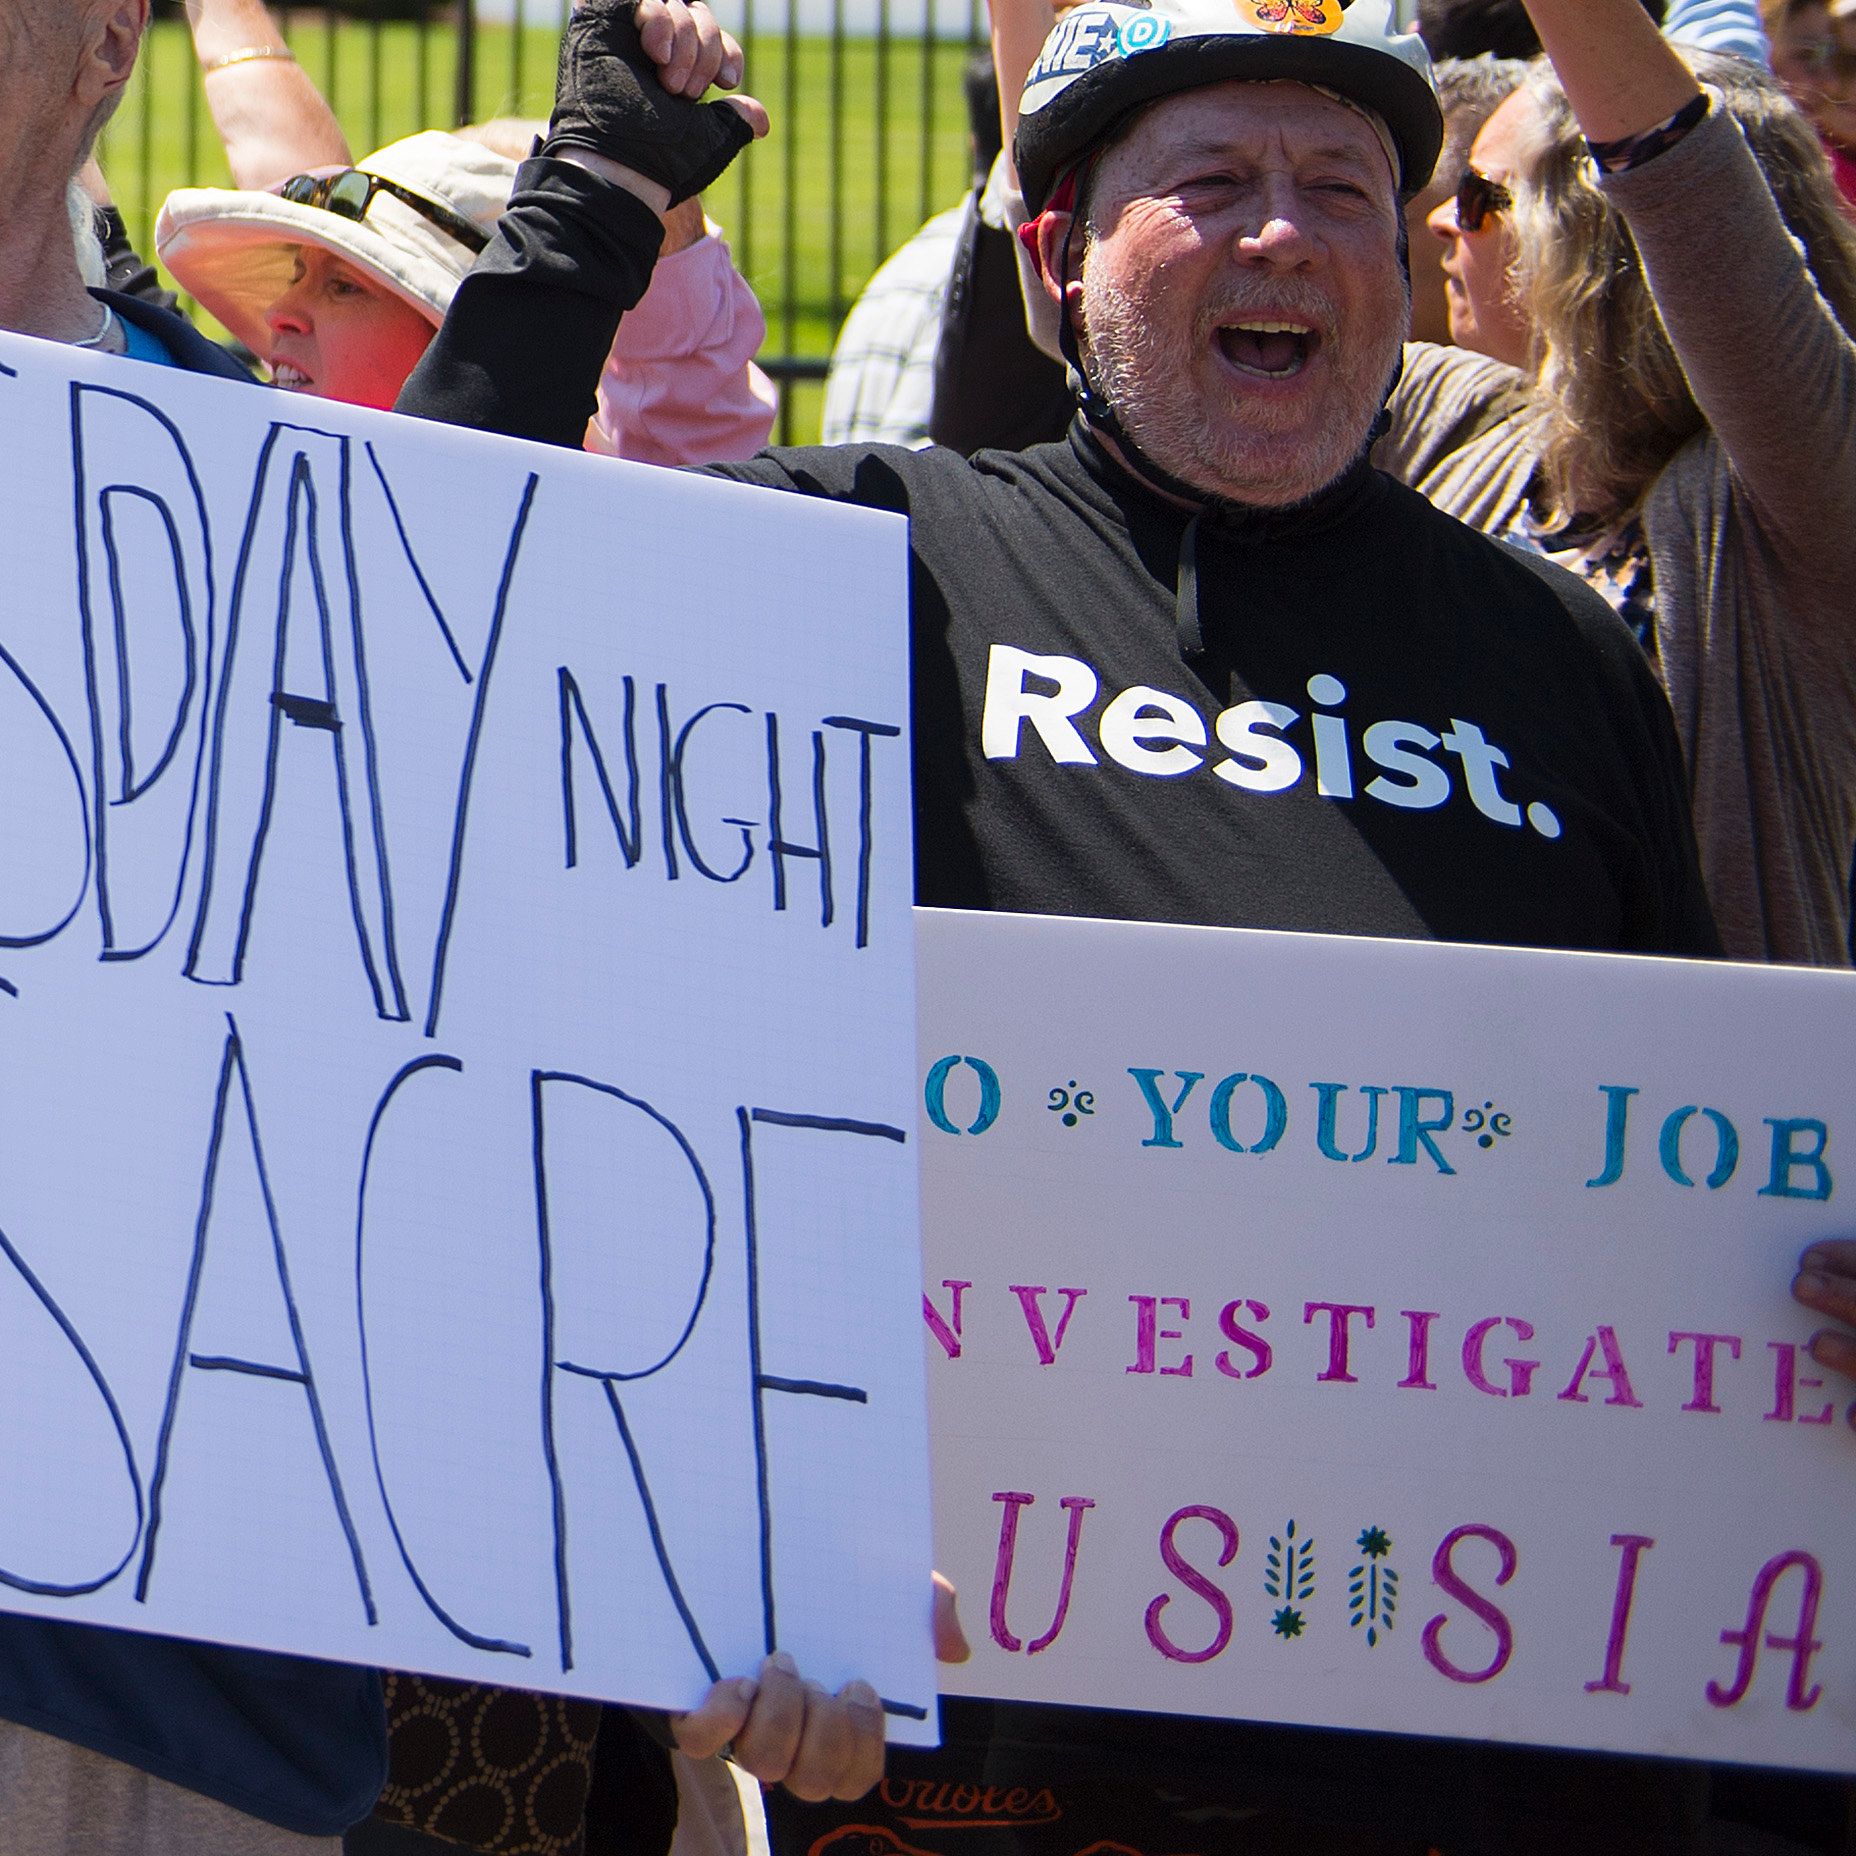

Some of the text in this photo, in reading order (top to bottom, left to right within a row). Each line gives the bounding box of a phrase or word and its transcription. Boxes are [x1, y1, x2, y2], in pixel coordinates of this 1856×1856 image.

[556, 665, 902, 949] NIGHT
[981, 642, 1563, 840] Resist.
[1127, 1066, 1458, 1176] YOUR
[1584, 1084, 1835, 1202] JOB
